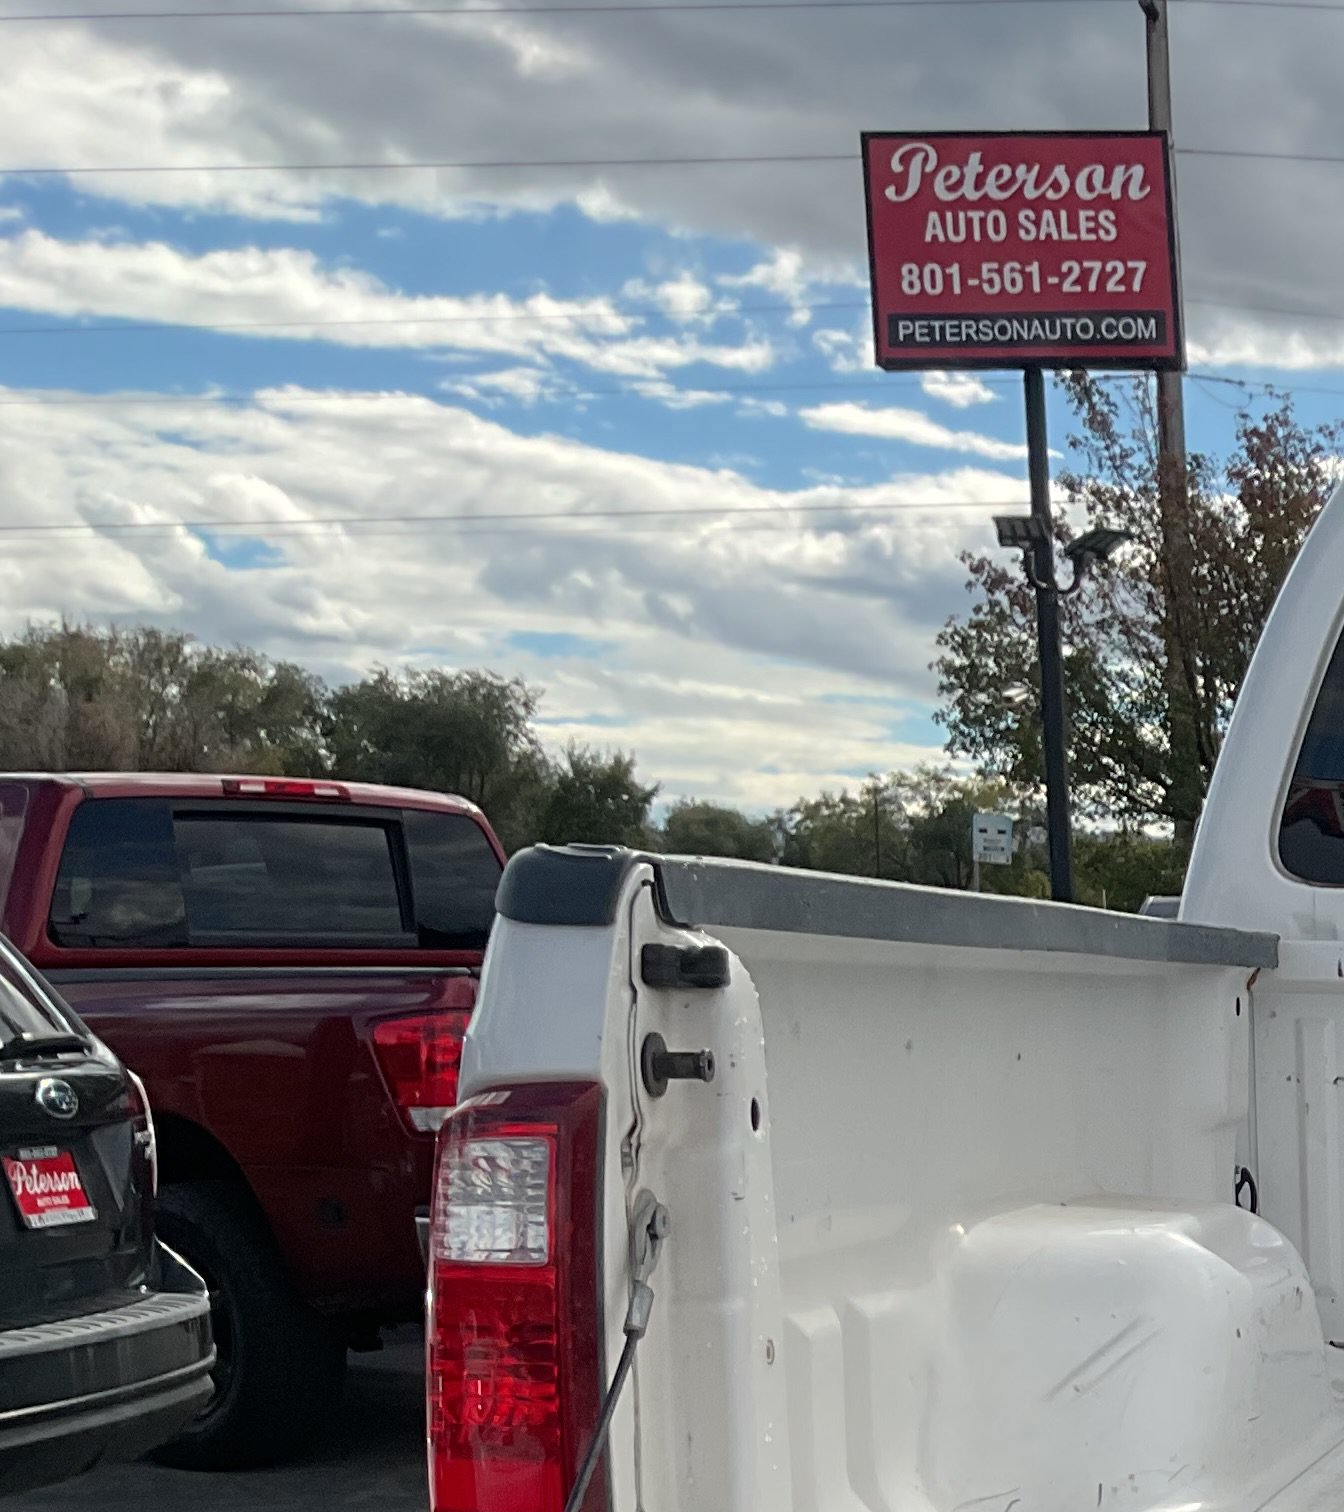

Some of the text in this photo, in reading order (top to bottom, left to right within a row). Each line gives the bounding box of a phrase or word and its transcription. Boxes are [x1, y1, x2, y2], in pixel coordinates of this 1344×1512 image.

[884, 141, 1151, 202] Peterson
[924, 208, 1119, 243] AUTO SALES
[900, 260, 1148, 296] 801-561-2727
[897, 317, 1158, 343] PETERSONAUTO.COM
[7, 1160, 82, 1196] Peterson
